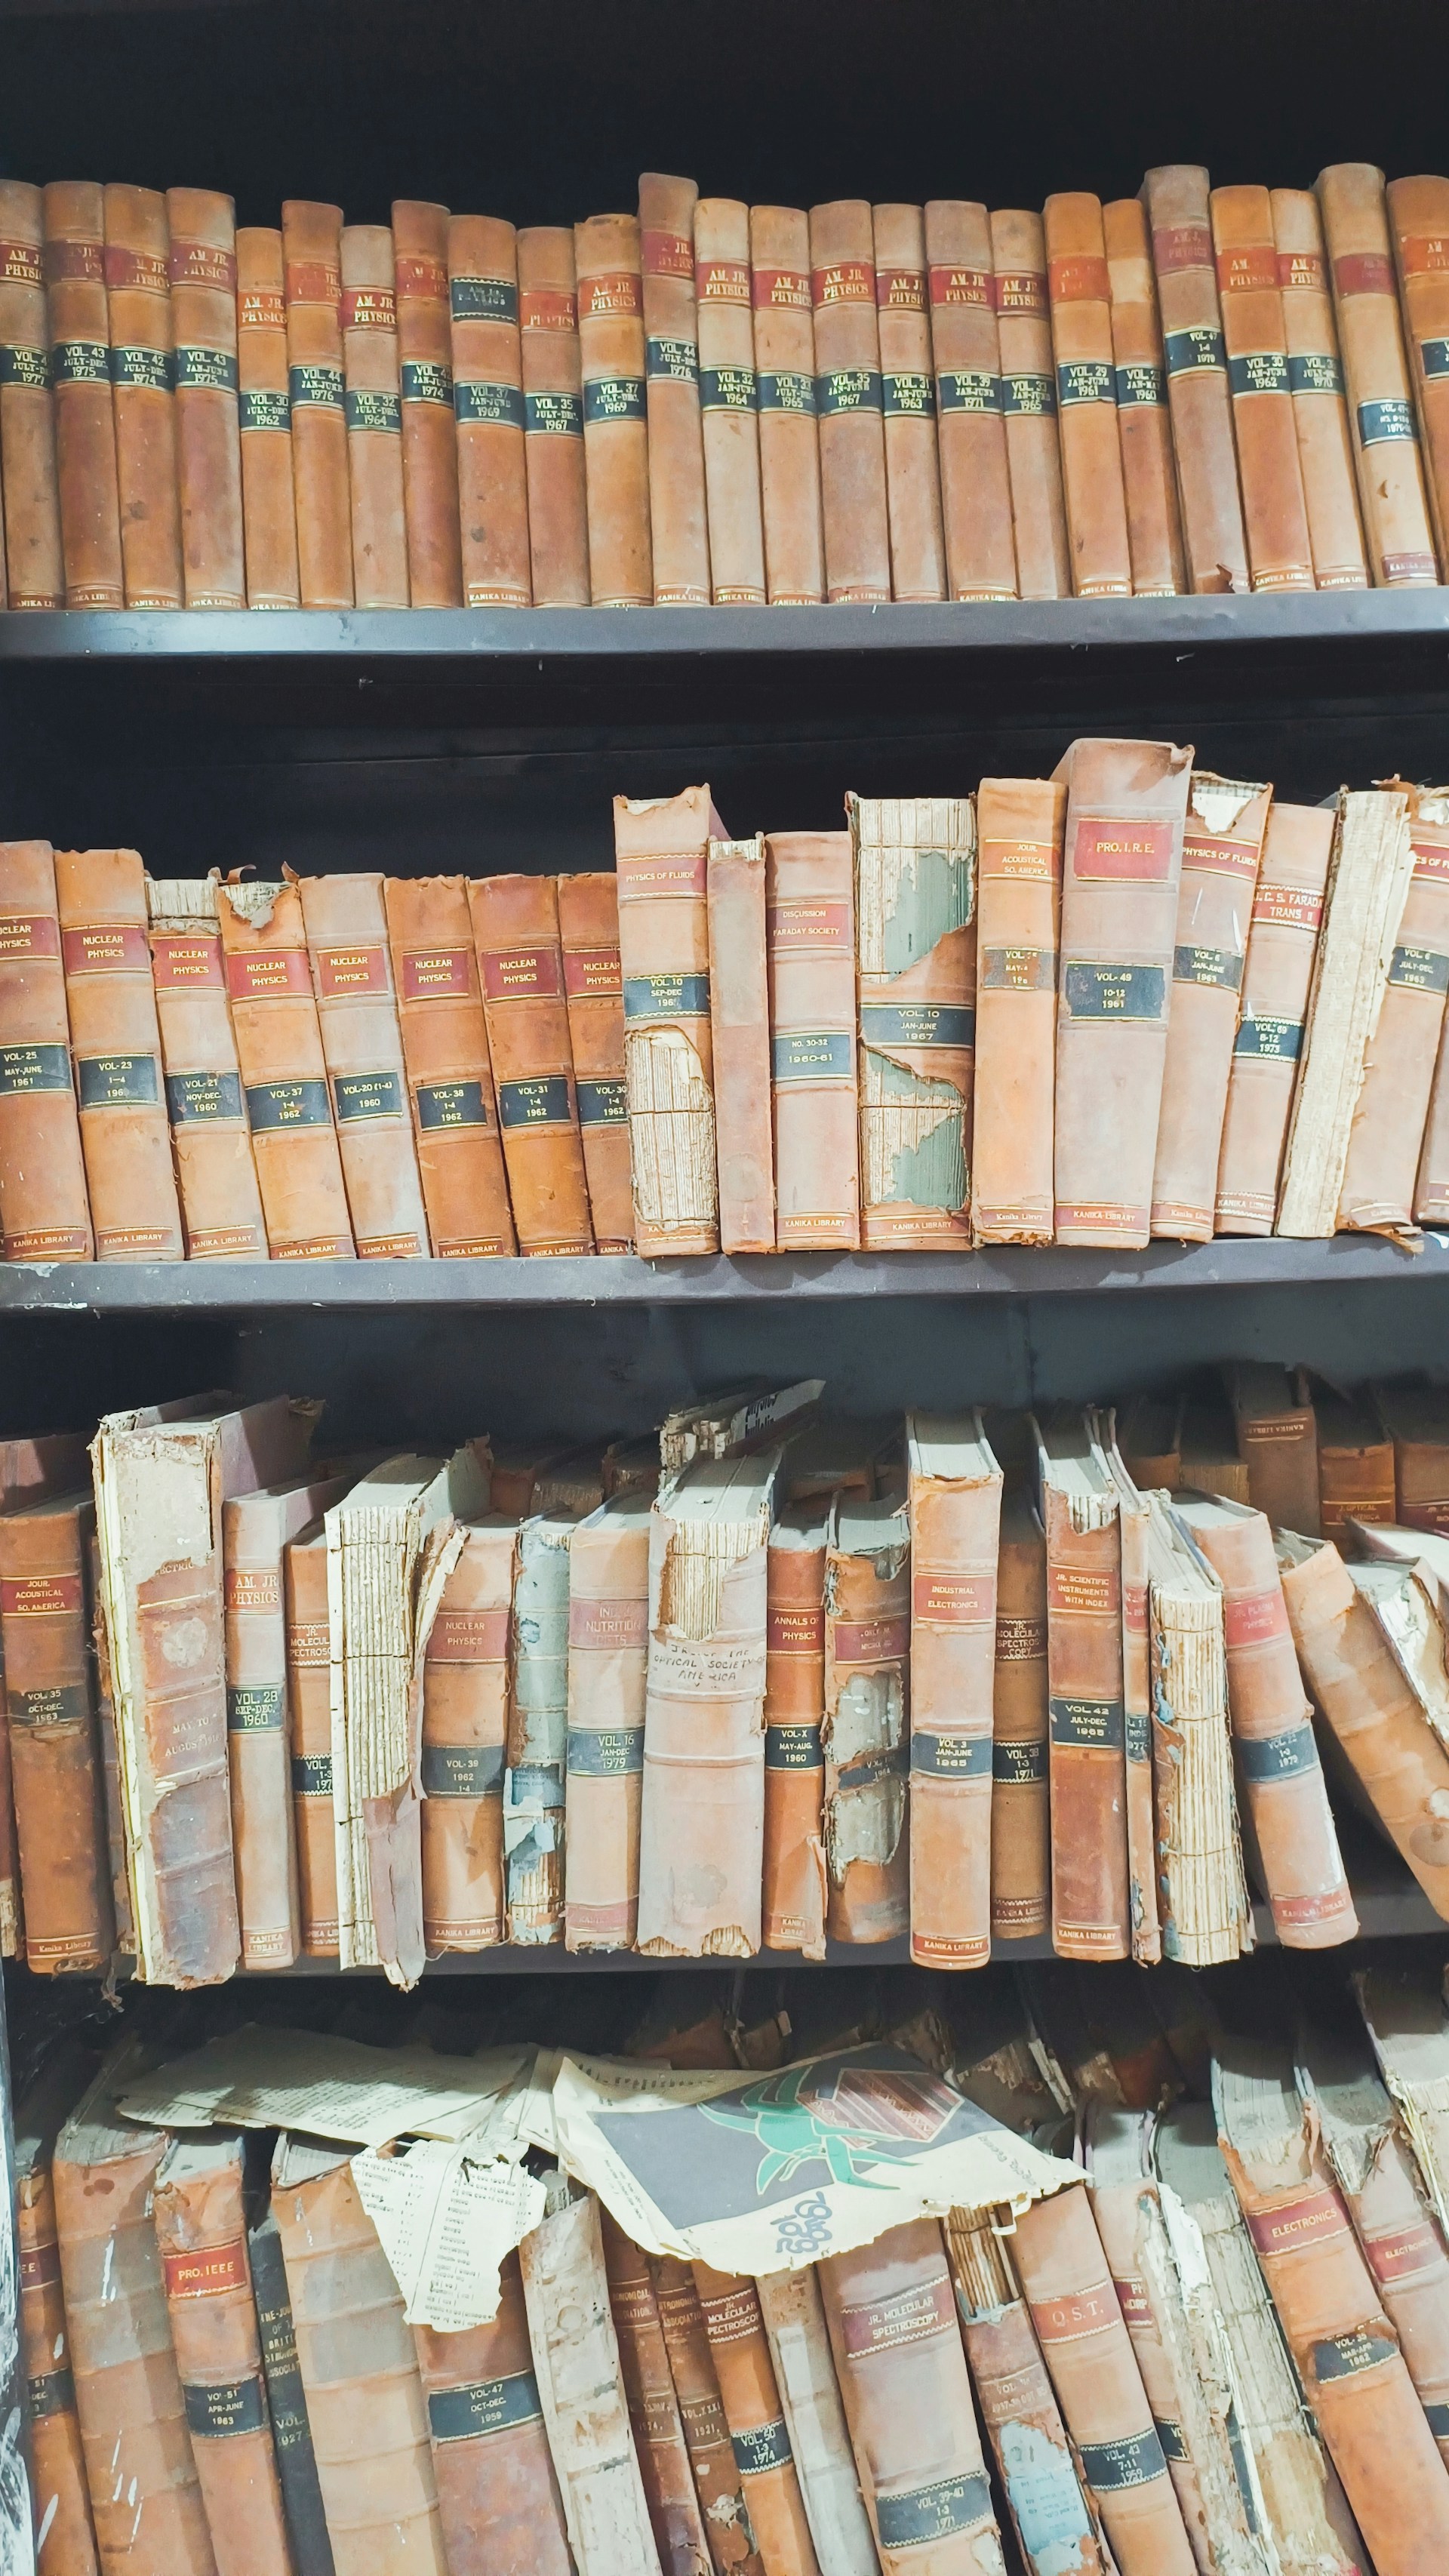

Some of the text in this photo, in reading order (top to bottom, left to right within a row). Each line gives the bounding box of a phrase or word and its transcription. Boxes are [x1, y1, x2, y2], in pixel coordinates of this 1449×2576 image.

[823, 285, 868, 299] PHYSICS
[946, 291, 987, 303] PHYSICS
[1272, 357, 1283, 367] 30
[1247, 368, 1287, 377] JAN-JUNE
[742, 373, 753, 384] 32
[857, 373, 869, 383] 35
[980, 378, 990, 387] 39
[1255, 377, 1277, 388] 1962
[828, 382, 869, 395] JAN-JUNE
[276, 395, 288, 406] 30
[726, 392, 747, 405] 1964
[838, 394, 860, 406] 1967
[964, 398, 983, 408] 1971
[257, 416, 279, 426] 1962
[1017, 844, 1037, 853] JOUR.
[1097, 842, 1121, 853] PRO.
[1002, 856, 1046, 866] ACOUSTICAL
[1018, 866, 1049, 876] AMERICA
[626, 873, 655, 882] PHYSICS
[783, 910, 826, 919] DISCUSSION
[1270, 906, 1302, 919] TRANS
[774, 928, 805, 936] FARADAY
[83, 935, 123, 945] NUCLEAR
[88, 949, 124, 959] PHYSICS
[169, 950, 208, 959] NUCLEAR
[500, 959, 537, 969] NUCLEAR
[173, 965, 209, 974] PHYSICS
[503, 974, 537, 983] PHYSICS
[651, 989, 681, 997] SEP-DEC
[1103, 989, 1125, 998] 10-12
[1102, 999, 1124, 1008] 1961
[900, 1022, 937, 1031] JAN-JUNE
[792, 1039, 803, 1048] NO.
[1260, 1044, 1279, 1054] 1973
[789, 1054, 833, 1063] 1960-61
[194, 1103, 217, 1112] 1960
[526, 1107, 546, 1117] 1962
[1022, 1214, 1043, 1222] Library
[785, 1219, 844, 1228] KANIKA LIBRARY
[14, 1235, 73, 1248] KANIKA LIBRARY
[363, 1241, 417, 1254] KANIKA LIBRARY
[1069, 1576, 1109, 1585] SCIENTIFIC
[15, 1590, 63, 1599] ACOUSTICAL
[932, 1586, 974, 1594] INDUSTRIAL
[1058, 1585, 1109, 1596] INSTRUMENTS
[229, 1592, 278, 1604] PHYSICS
[1065, 1596, 1108, 1607] WITH INDEX
[928, 1600, 978, 1608] ELECTRONICS
[446, 1622, 485, 1630] NUCLEAR
[774, 1617, 808, 1625] ANNALS
[783, 1632, 816, 1640] PHYSICS
[48, 1690, 61, 1698] 35
[263, 1691, 278, 1703] 28
[243, 1715, 268, 1725] 1960
[782, 1729, 808, 1738] VOL-X
[624, 1734, 634, 1744] 16
[936, 1748, 972, 1756] JAN-JUNE
[786, 1753, 807, 1762] 1960
[936, 1758, 967, 1767] 1965
[603, 1758, 626, 1768] 1979
[250, 1934, 283, 1944] KANIKA
[248, 1941, 284, 1952] LIBRARY
[1272, 2208, 1337, 2238] ELECTRONICS
[1386, 2236, 1432, 2259] ELECTRONICS
[178, 2261, 234, 2280] PRO. IEEE
[884, 2296, 934, 2320] MOLECULAR
[872, 2311, 940, 2339] SPECTROSCOPY
[1349, 2353, 1371, 2368] 1962
[208, 2401, 244, 2413] APR-JUNE
[481, 2411, 502, 2424] 1959
[764, 2428, 775, 2440] 50
[1129, 2445, 1140, 2456] 43
[752, 2451, 775, 2464] 1974
[1118, 2460, 1137, 2470] 7-11
[940, 2487, 964, 2504] 39-40
[937, 2506, 949, 2514] 1-3
[936, 2516, 955, 2528] 1971
